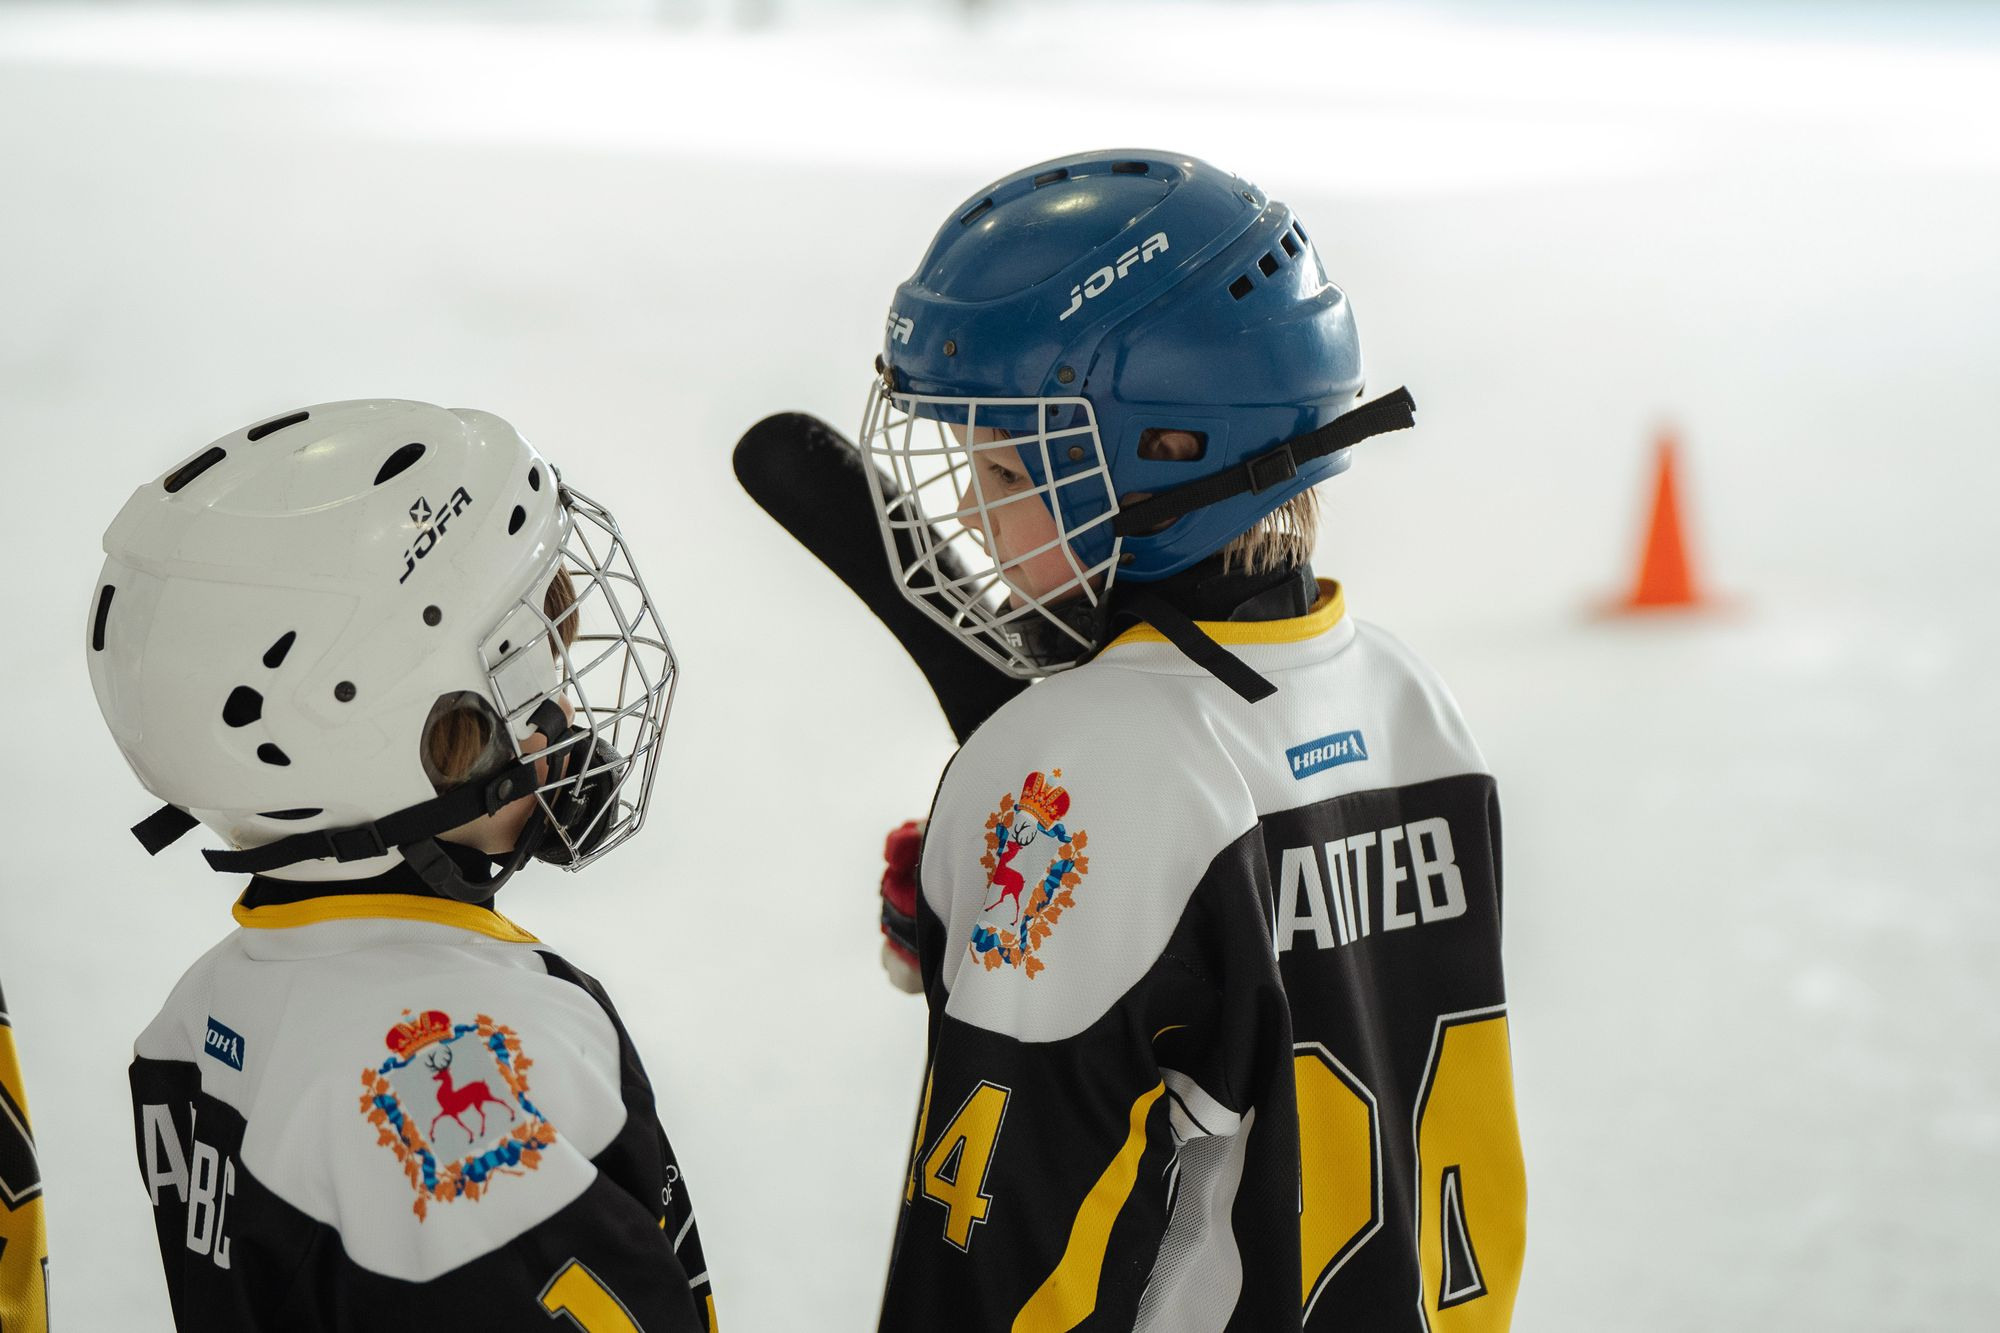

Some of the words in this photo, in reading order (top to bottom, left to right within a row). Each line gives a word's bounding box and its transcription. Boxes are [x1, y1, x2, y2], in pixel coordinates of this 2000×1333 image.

[1059, 231, 1170, 321] JOFA
[399, 486, 473, 584] JOFA
[1273, 816, 1467, 962] АПТЕВ
[906, 1079, 1012, 1253] 4
